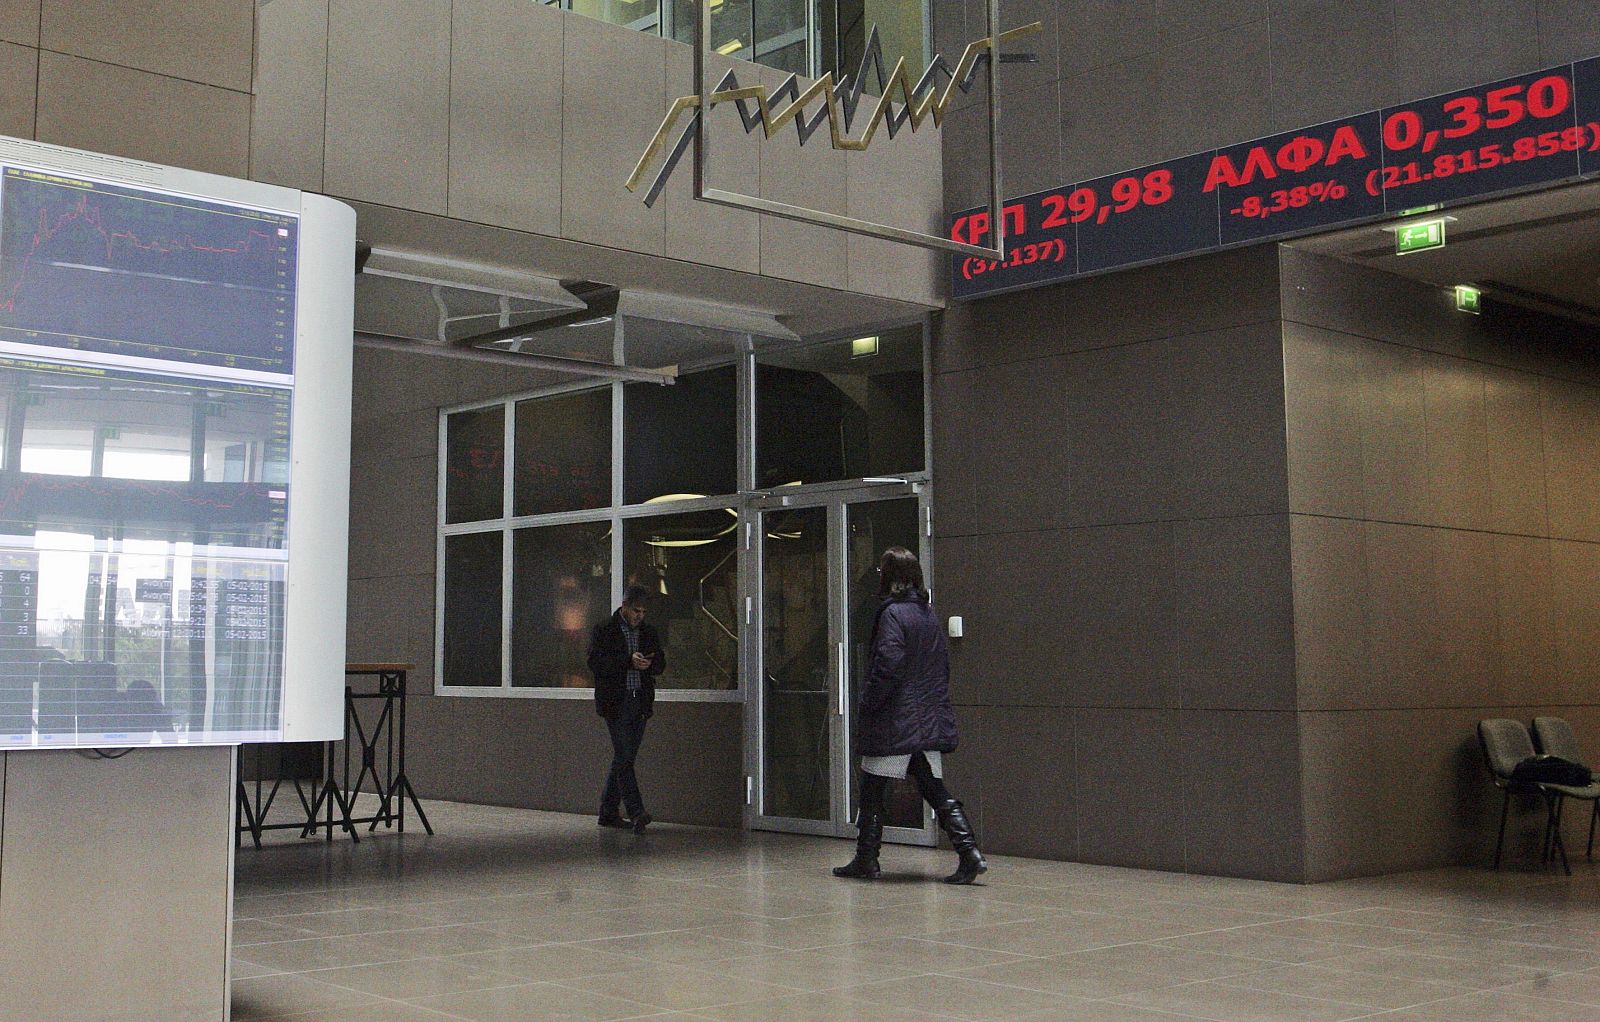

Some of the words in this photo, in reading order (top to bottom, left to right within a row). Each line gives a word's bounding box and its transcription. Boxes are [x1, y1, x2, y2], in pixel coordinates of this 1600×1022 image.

[1202, 126, 1367, 193] ΑΛΦΑ
[1383, 75, 1569, 152] 0,350
[1230, 180, 1346, 218] -8,38%
[1366, 123, 1600, 197] (21.815.858)
[1041, 170, 1172, 228] 29,98
